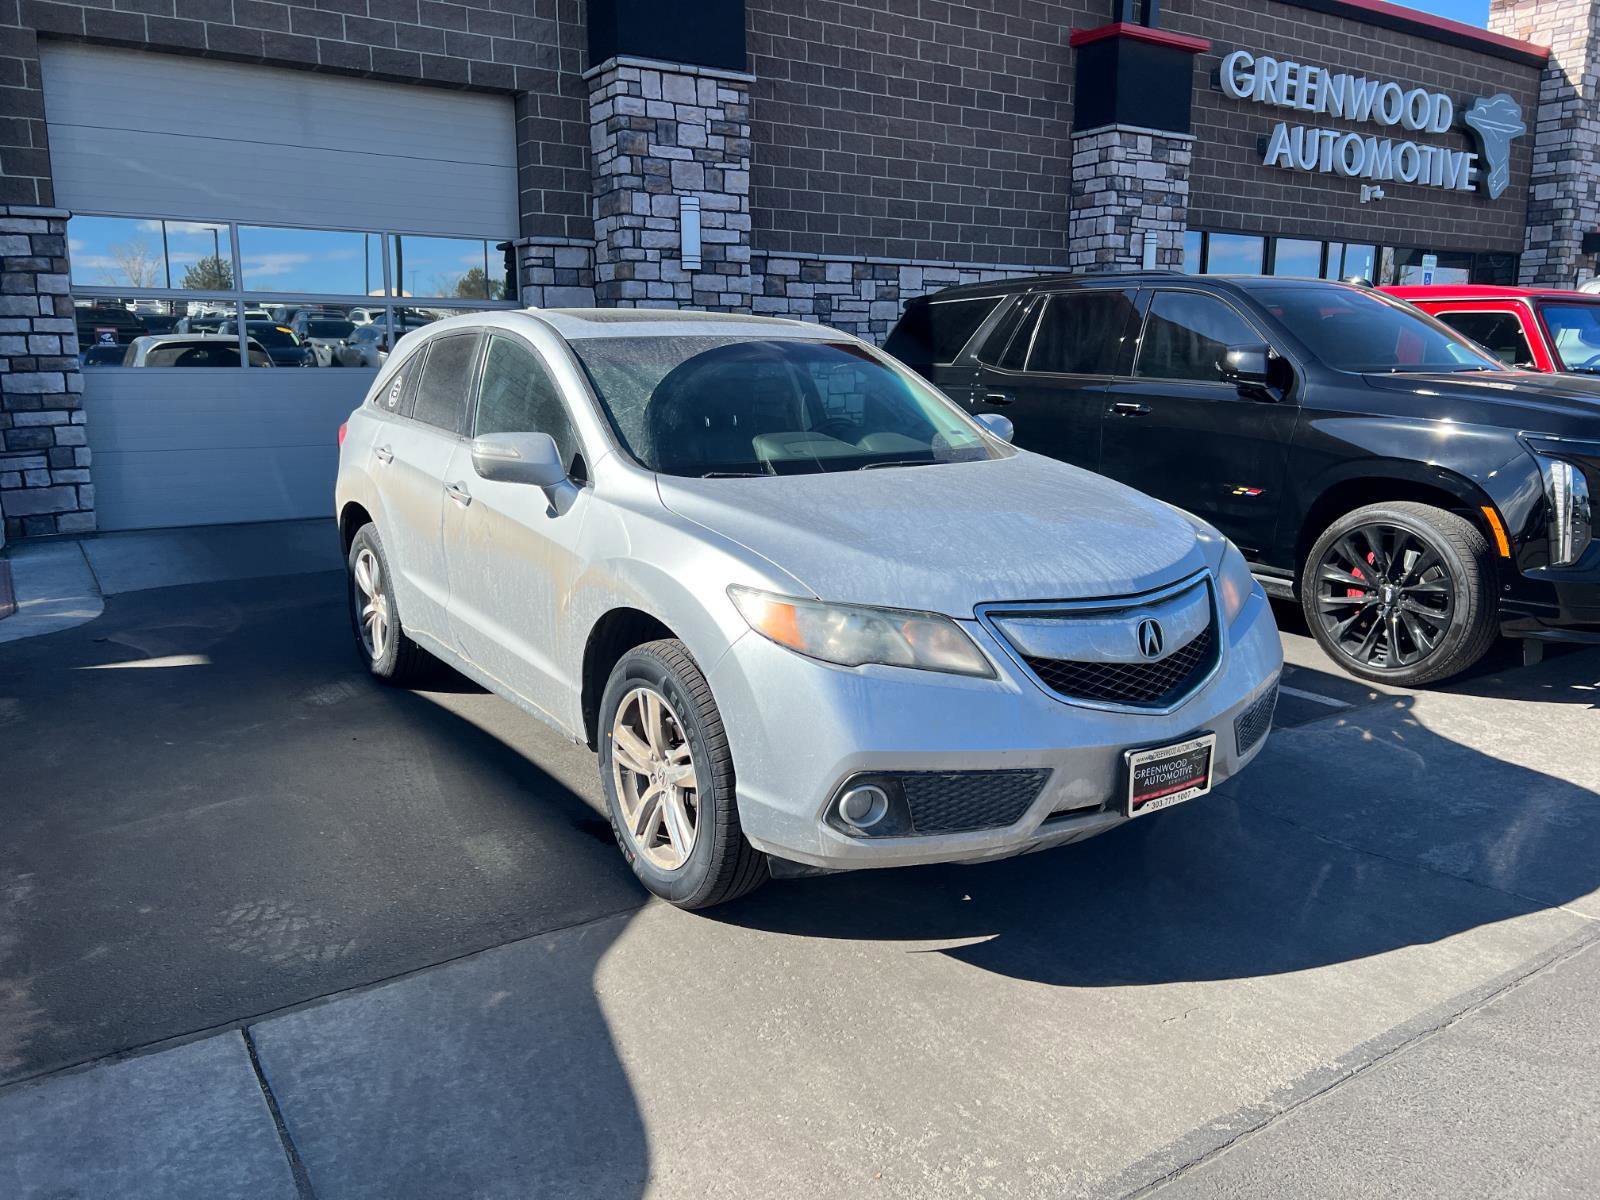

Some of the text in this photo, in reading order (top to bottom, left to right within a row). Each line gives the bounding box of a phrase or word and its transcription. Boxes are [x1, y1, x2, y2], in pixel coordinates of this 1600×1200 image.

[1220, 50, 1454, 134] GREENWOOD
[1263, 122, 1479, 192] AUTOMOTIVE
[1134, 758, 1188, 780] GREENWOOD
[1143, 764, 1193, 787] AUTOMOTIVE
